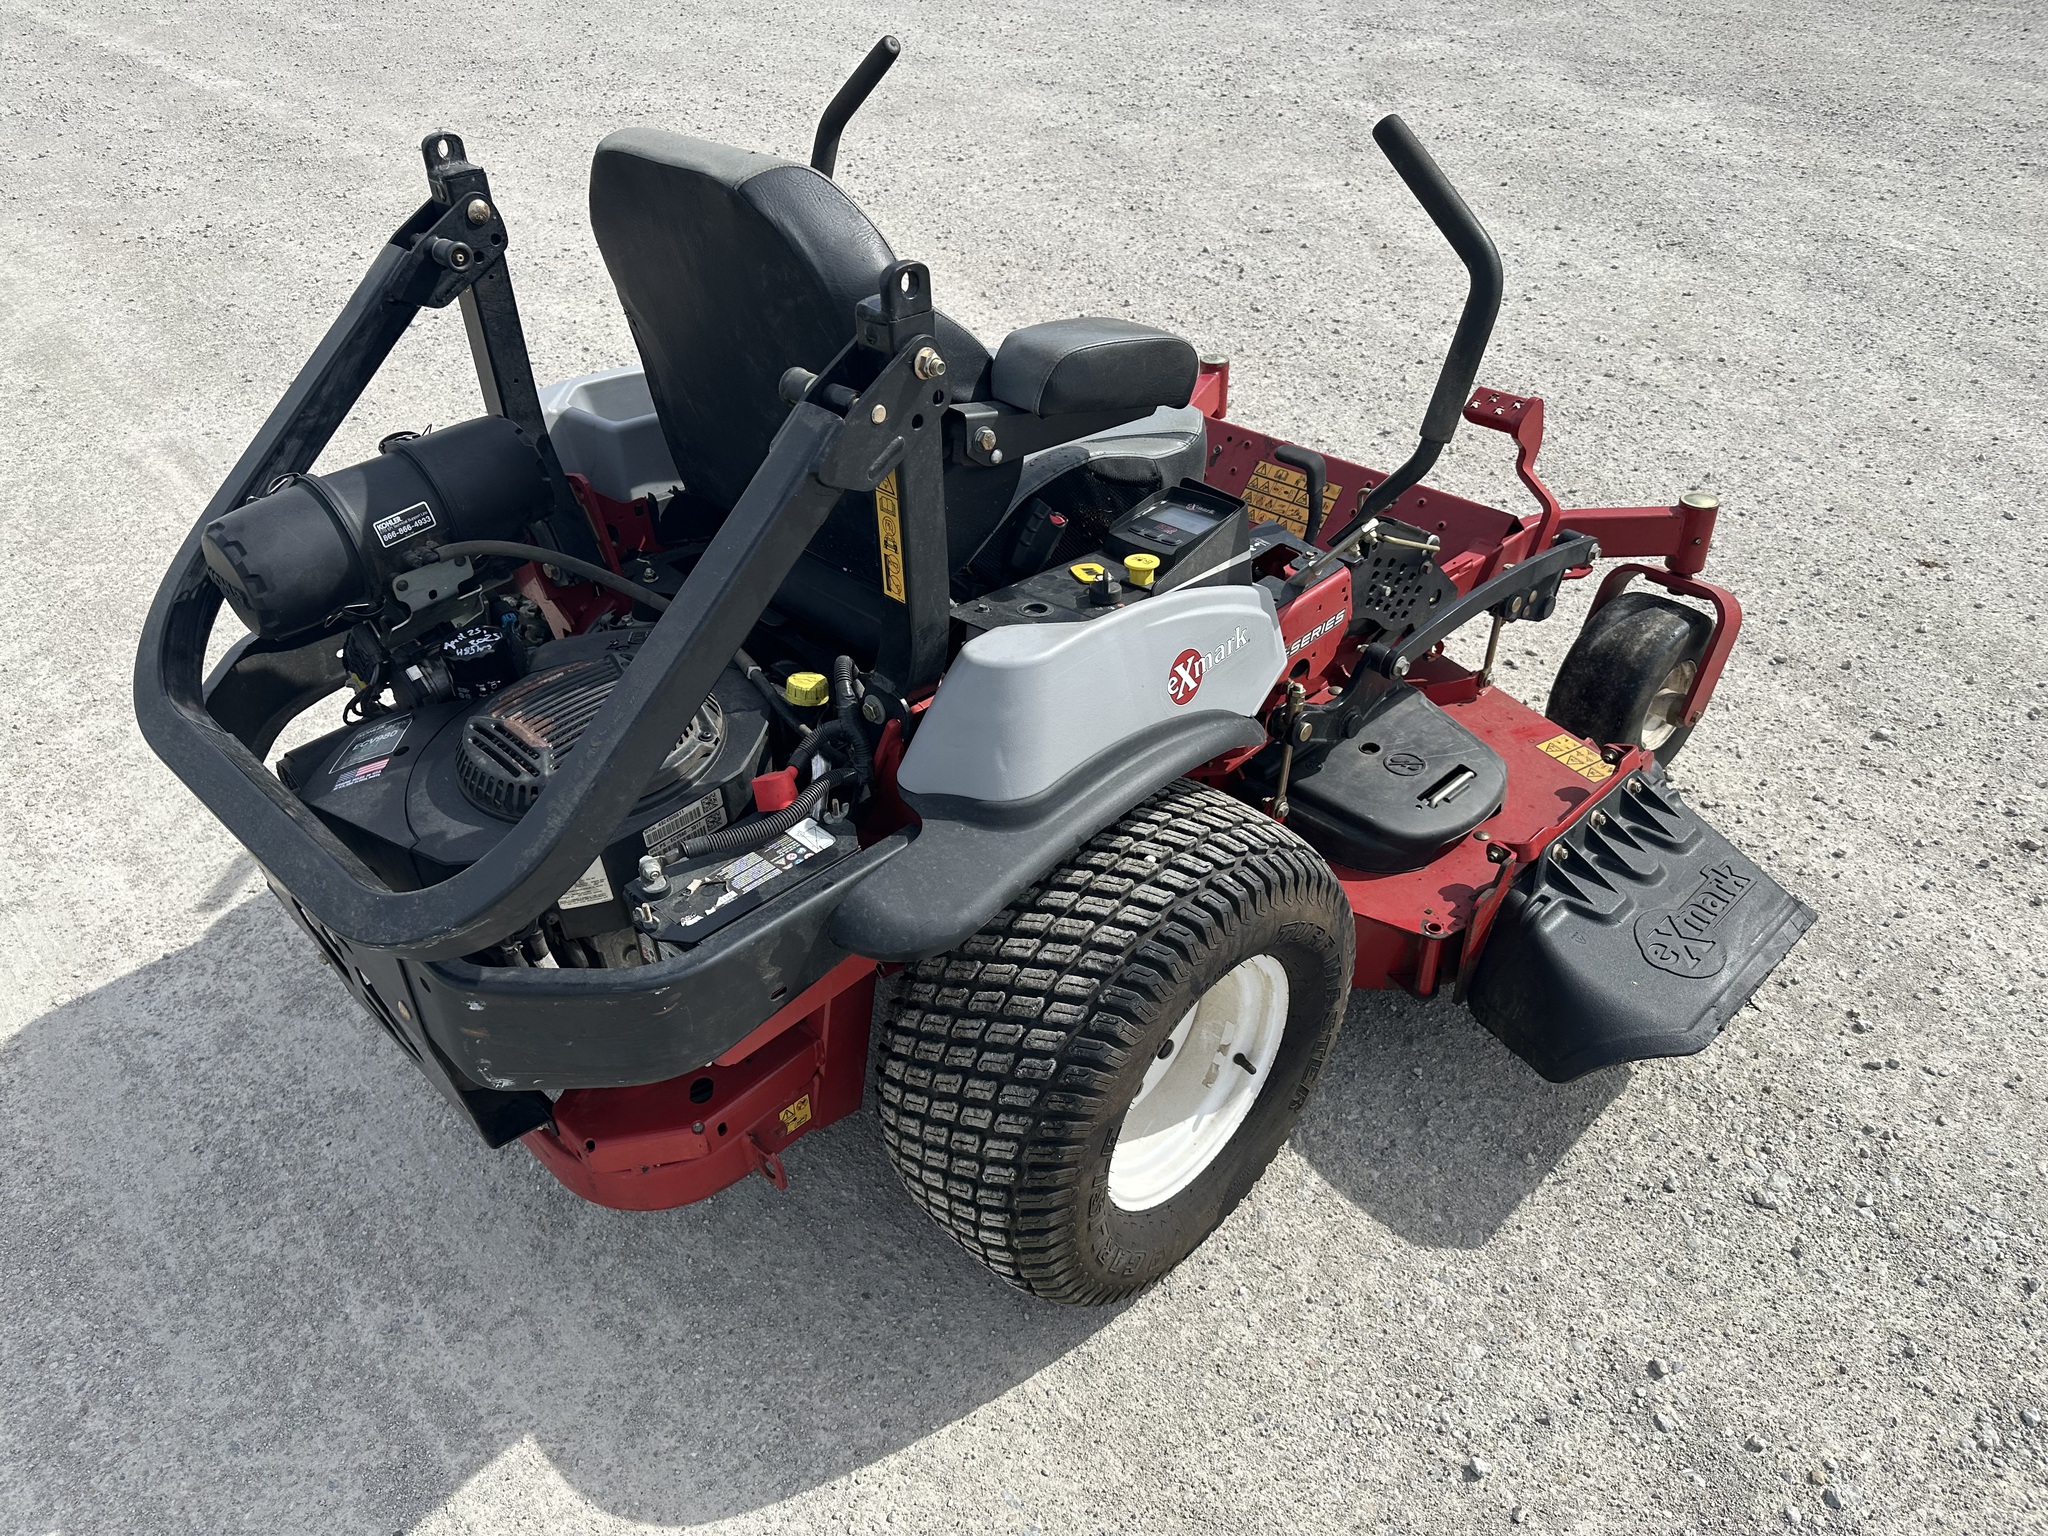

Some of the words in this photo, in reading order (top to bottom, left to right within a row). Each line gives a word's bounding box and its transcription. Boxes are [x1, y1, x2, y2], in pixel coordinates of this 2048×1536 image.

[377, 516, 402, 531] KOHLER
[383, 515, 432, 542] 866-866-4933
[444, 633, 467, 650] April
[1167, 625, 1249, 700] eXmark
[1647, 861, 1753, 970] eXmark
[1274, 920, 1336, 952] TURF
[1288, 951, 1343, 1114] MASTER
